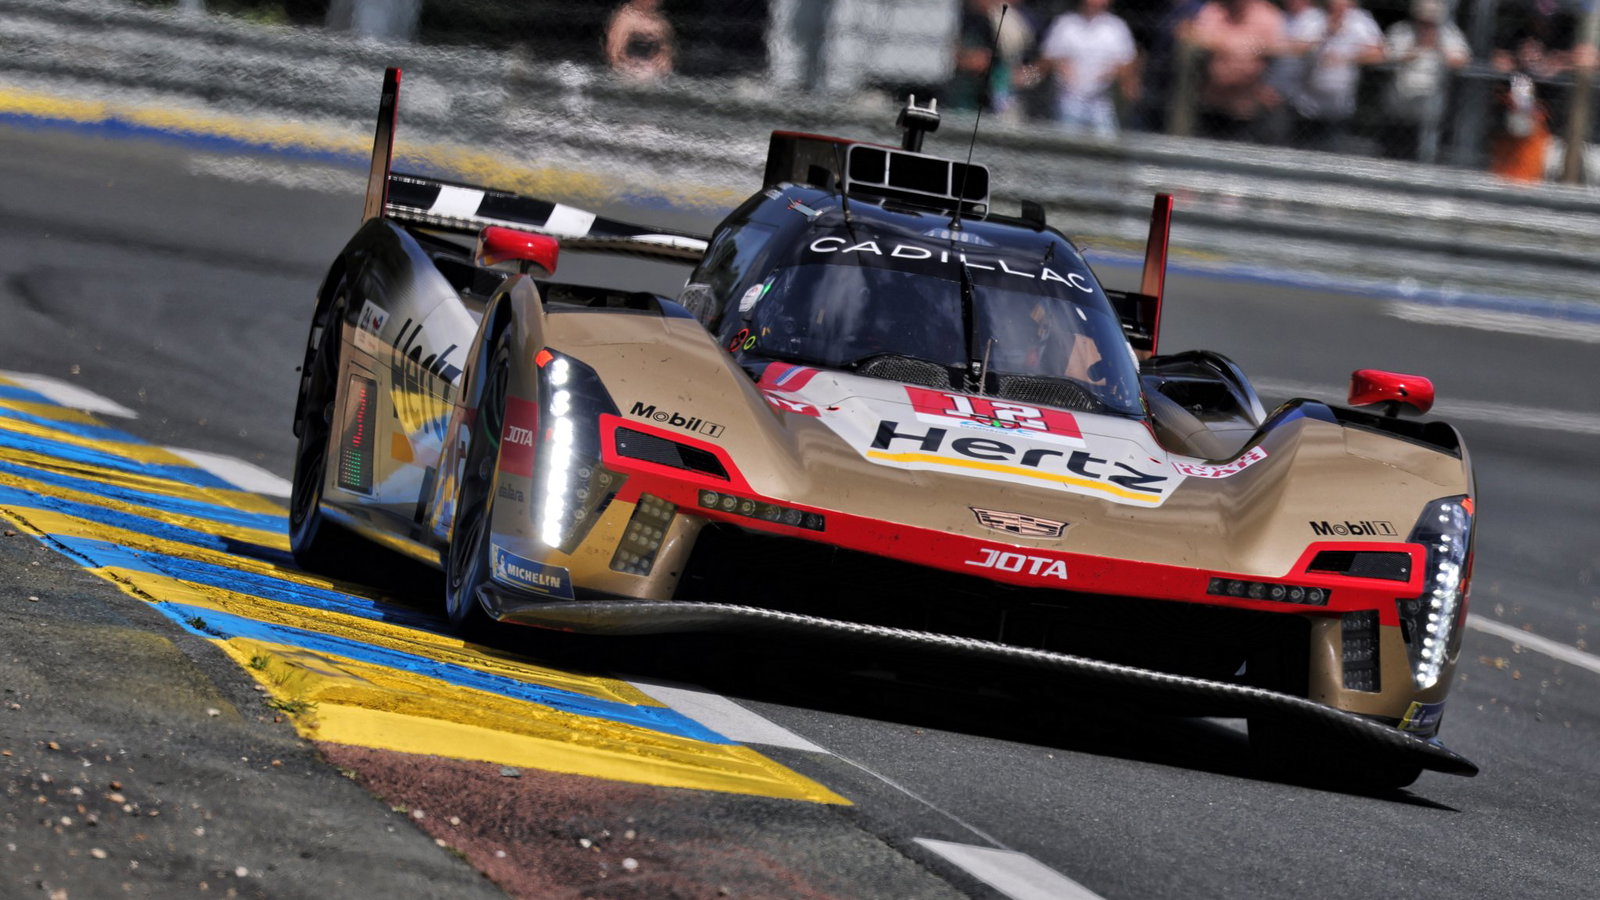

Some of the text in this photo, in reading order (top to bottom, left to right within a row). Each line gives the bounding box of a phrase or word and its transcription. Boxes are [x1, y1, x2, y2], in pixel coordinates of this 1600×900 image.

[809, 236, 1094, 294] CADILLAC
[629, 401, 702, 432] Mobil
[942, 393, 1050, 431] 12
[504, 424, 533, 447] JOTA
[870, 419, 1168, 494] Hertz
[1309, 520, 1377, 536] Mobil
[507, 562, 561, 589] MICHELIN
[964, 547, 1069, 580] JOTA
